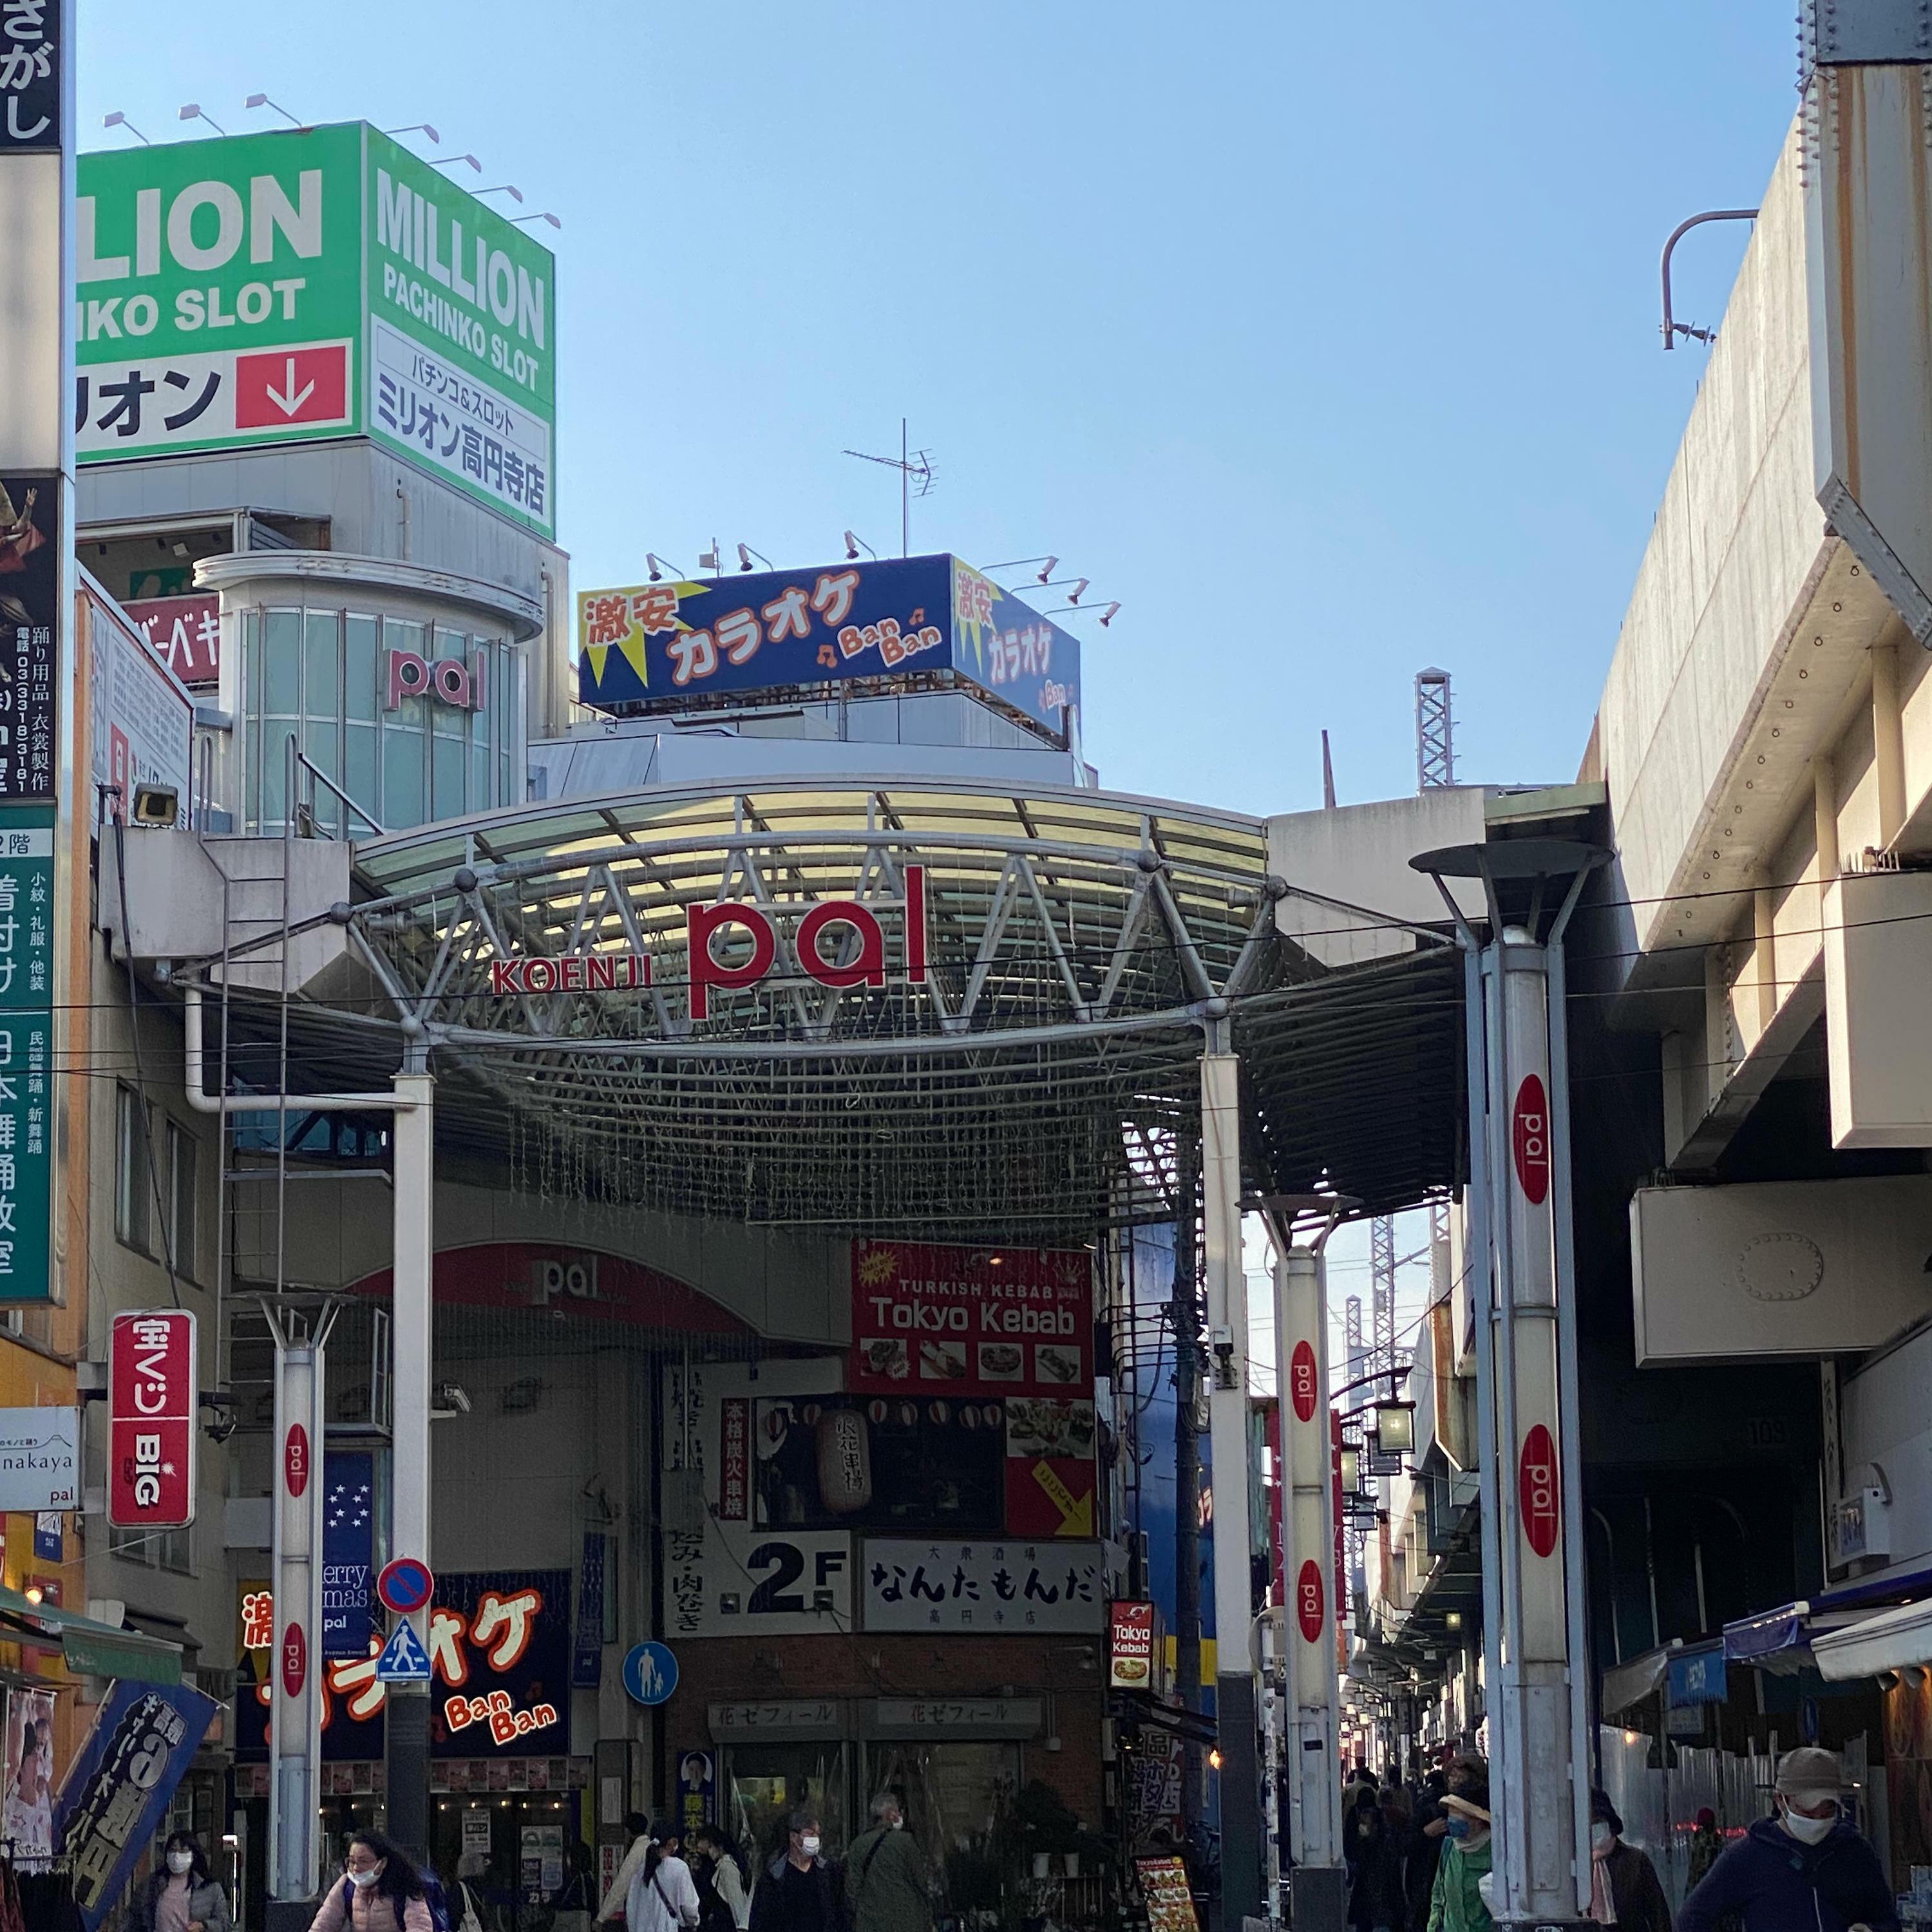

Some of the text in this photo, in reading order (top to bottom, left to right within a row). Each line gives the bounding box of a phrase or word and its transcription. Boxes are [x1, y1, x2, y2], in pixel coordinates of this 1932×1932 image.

[377, 167, 544, 350] MILLION
[174, 278, 306, 332] SLOT
[384, 261, 539, 392] PACHINKO SLOT
[412, 354, 514, 437] パチンコ&スロット
[377, 372, 545, 516] ミリオン高円寺店
[585, 587, 677, 646] 激安
[667, 571, 859, 684] カラオケ
[838, 618, 901, 659] Ban
[879, 625, 942, 668] Ban
[988, 625, 1052, 686] カラオケ
[388, 649, 485, 712] pal
[491, 865, 927, 1022] KOENJI pal
[1518, 1113, 1548, 1166] pal
[542, 1256, 598, 1305] pal
[899, 1279, 982, 1297] TURKISH
[991, 1283, 1053, 1299] KEBAB
[869, 1296, 1075, 1335] Tokyo Kebab
[133, 1320, 170, 1414] 宝くじ
[1293, 1364, 1315, 1398] pal
[3, 1453, 72, 1473] nakaya
[135, 1434, 160, 1507] BIG
[288, 1444, 305, 1477] pal
[50, 1486, 74, 1505] pal
[1525, 1463, 1557, 1519] pal
[929, 1546, 1036, 1561] 大衆酒場
[748, 1543, 847, 1614] 2F
[871, 1562, 1095, 1605] なんたもんだ
[929, 1609, 1036, 1624] 高円寺店
[1301, 1584, 1321, 1618] pal
[324, 1615, 346, 1633] pal
[1113, 1624, 1150, 1642] Tokyo
[285, 1645, 301, 1676] pal
[1112, 1641, 1150, 1653] Kebab
[444, 1689, 513, 1733] Ban
[488, 1702, 557, 1746] Ban
